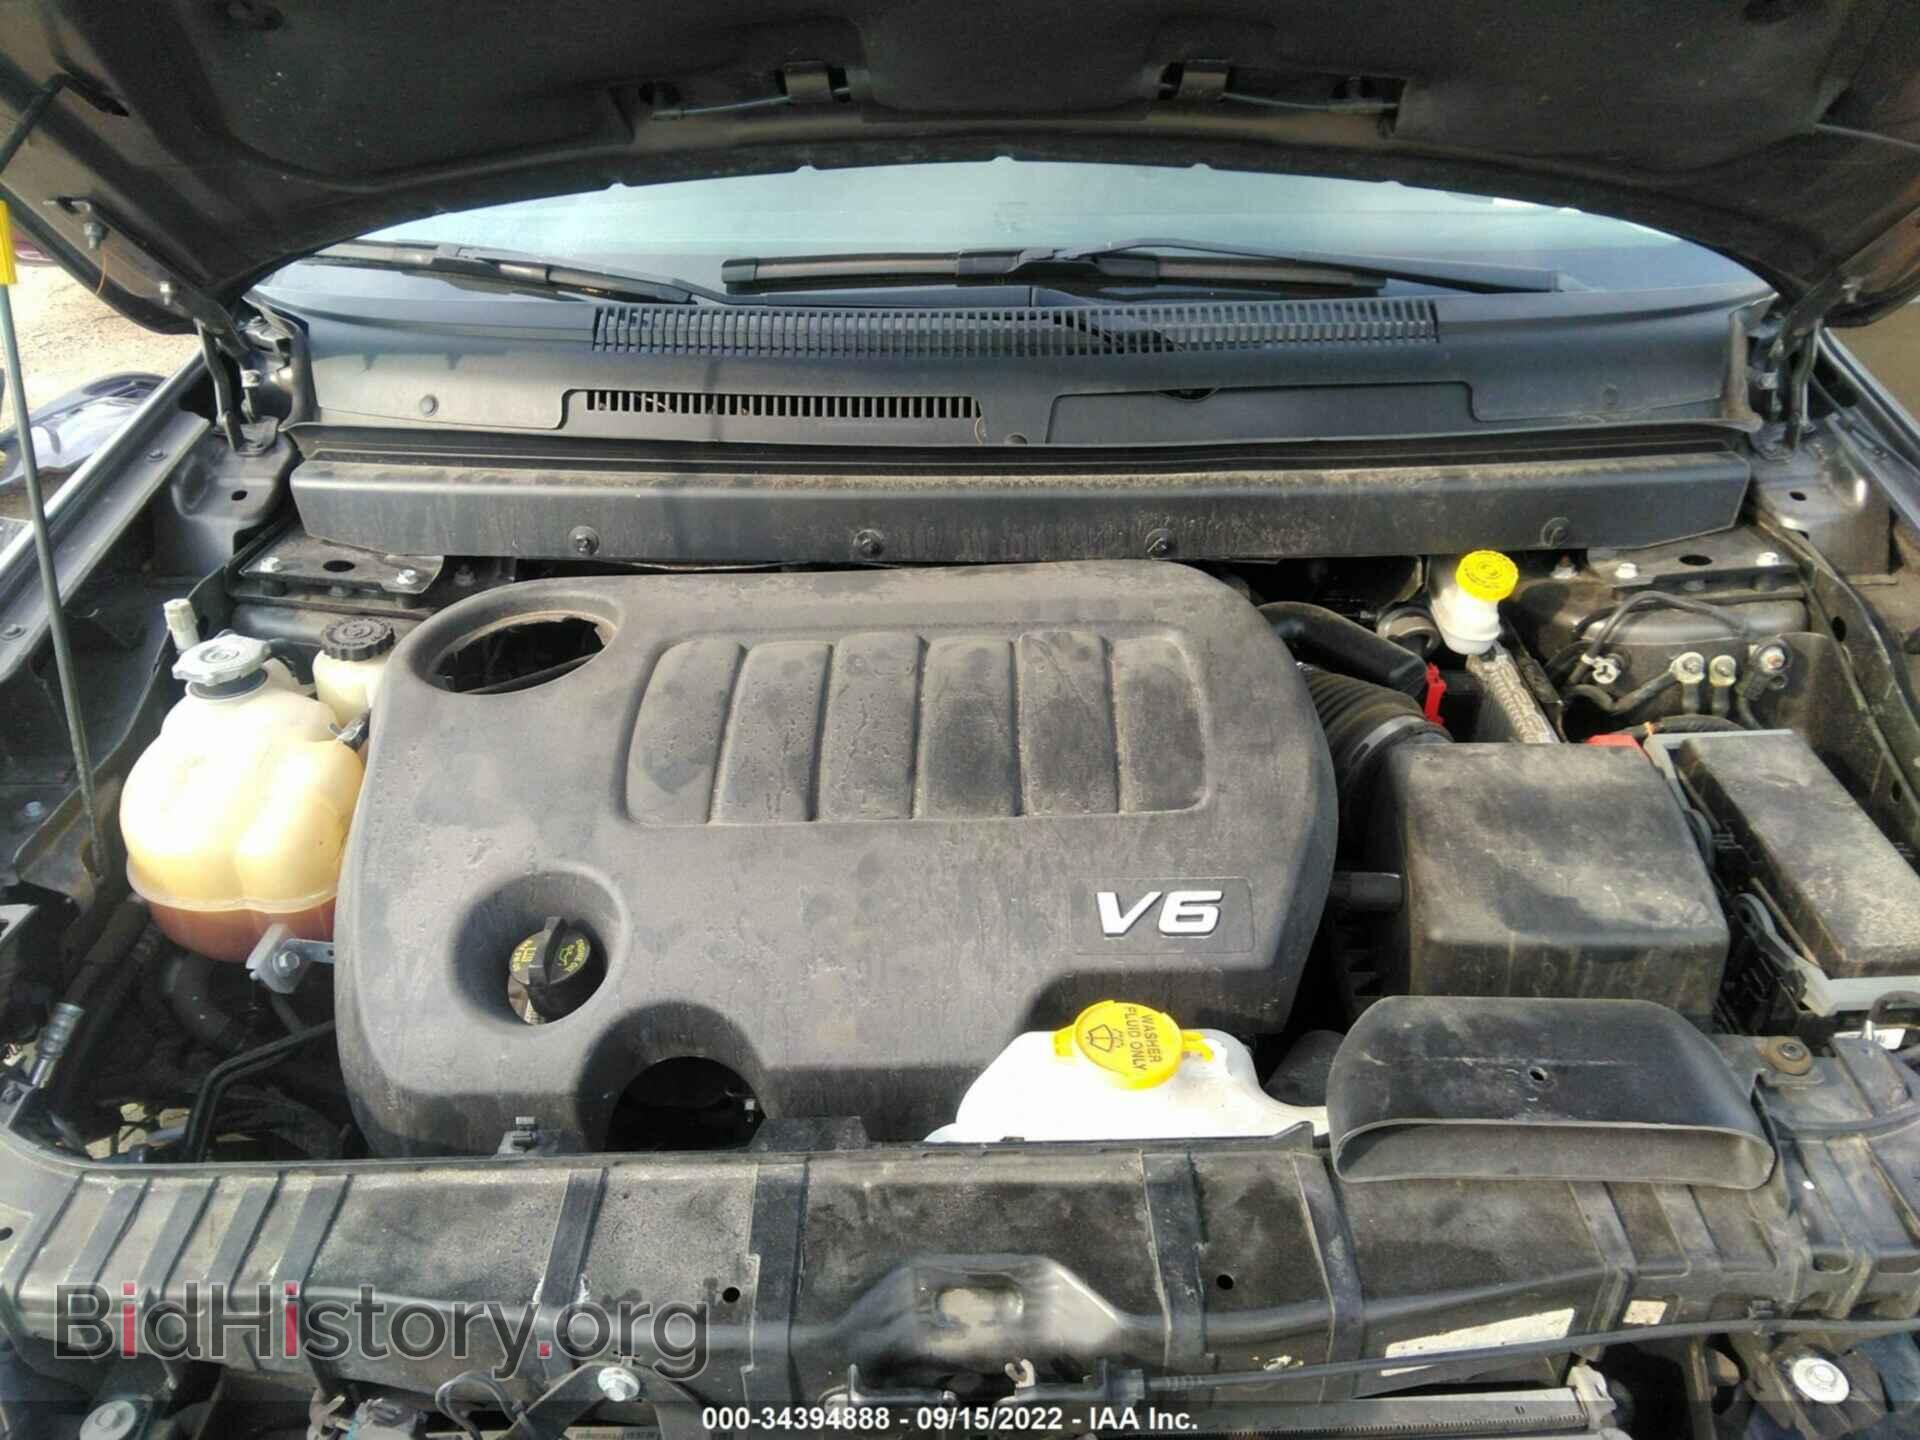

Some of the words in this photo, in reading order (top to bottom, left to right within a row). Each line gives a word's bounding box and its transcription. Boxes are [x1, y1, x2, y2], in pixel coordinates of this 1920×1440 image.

[1096, 890, 1223, 937] V6
[1124, 1006, 1141, 1038] FLUID
[1141, 1013, 1163, 1063] WASHER
[1129, 1041, 1147, 1071] ONLY
